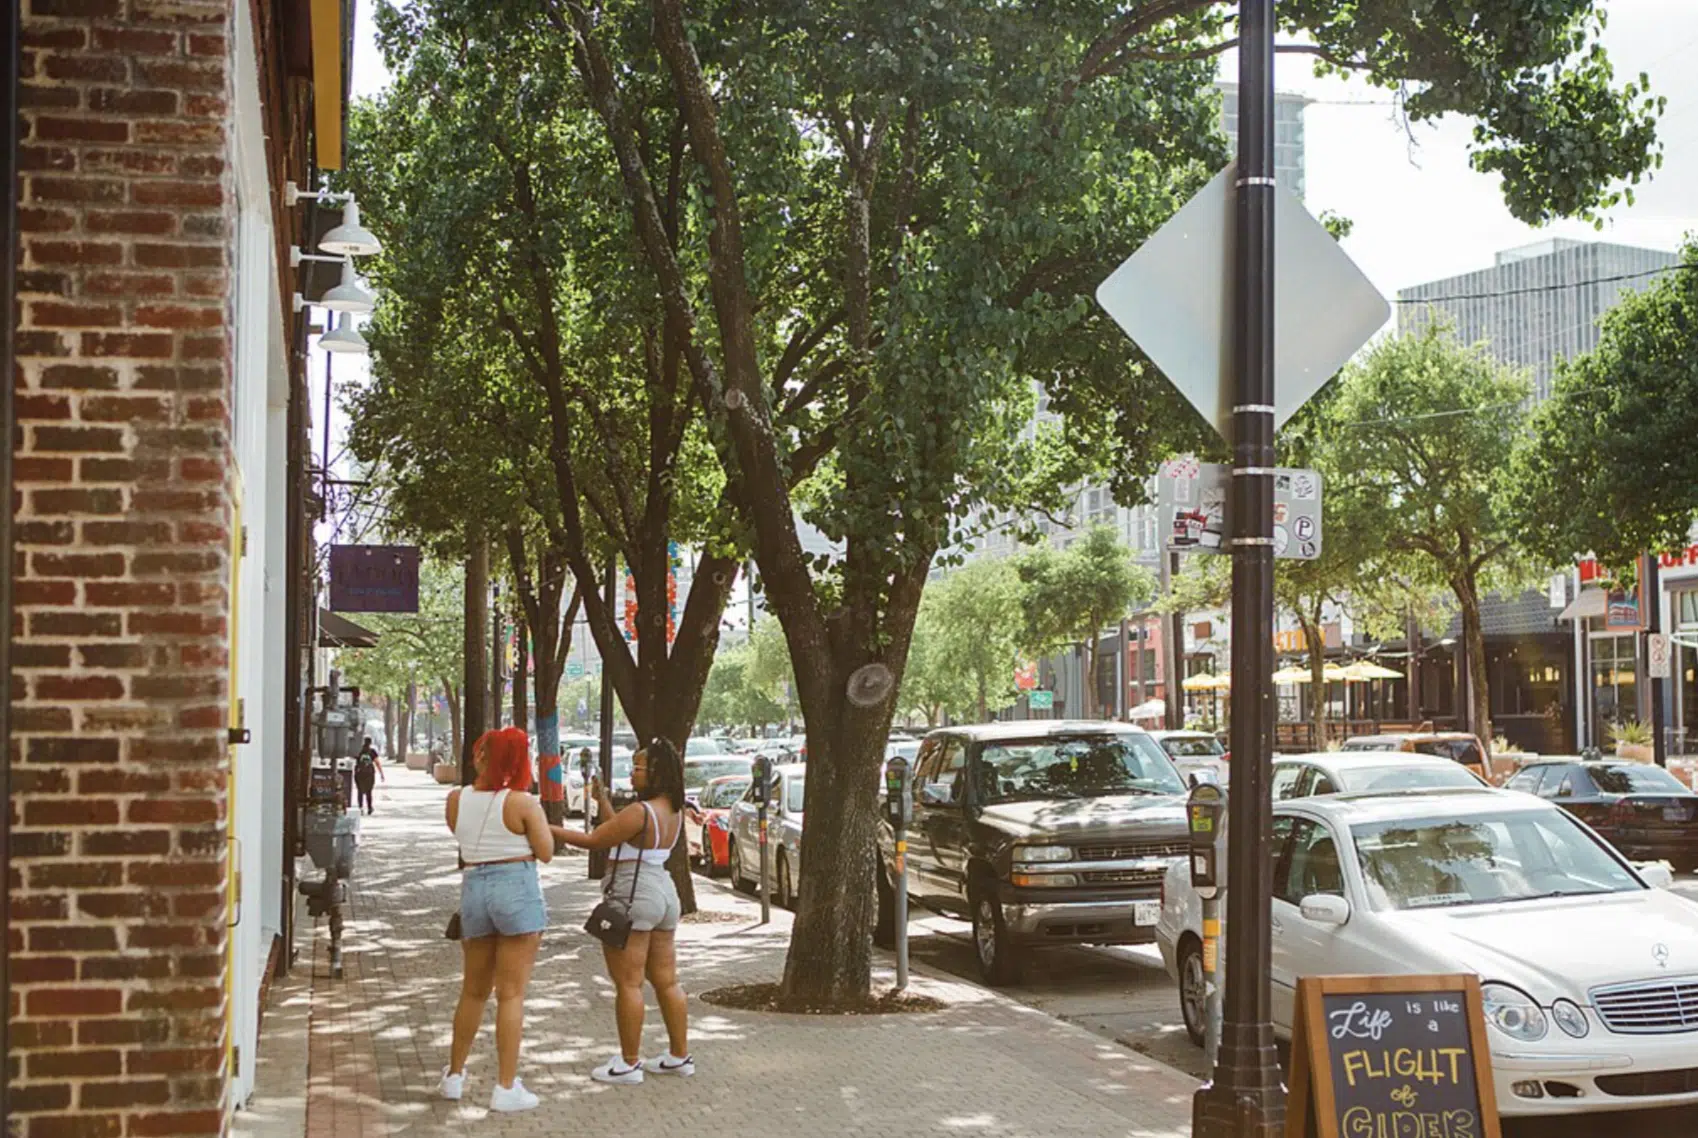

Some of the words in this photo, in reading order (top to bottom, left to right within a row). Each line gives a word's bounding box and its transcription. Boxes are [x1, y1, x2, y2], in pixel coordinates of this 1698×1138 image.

[1329, 1001, 1393, 1040] Life
[1406, 1001, 1421, 1014] is
[1433, 1000, 1460, 1013] like
[1427, 1019, 1439, 1032] a
[1342, 1047, 1467, 1086] FLIGHT
[1390, 1084, 1419, 1107] of
